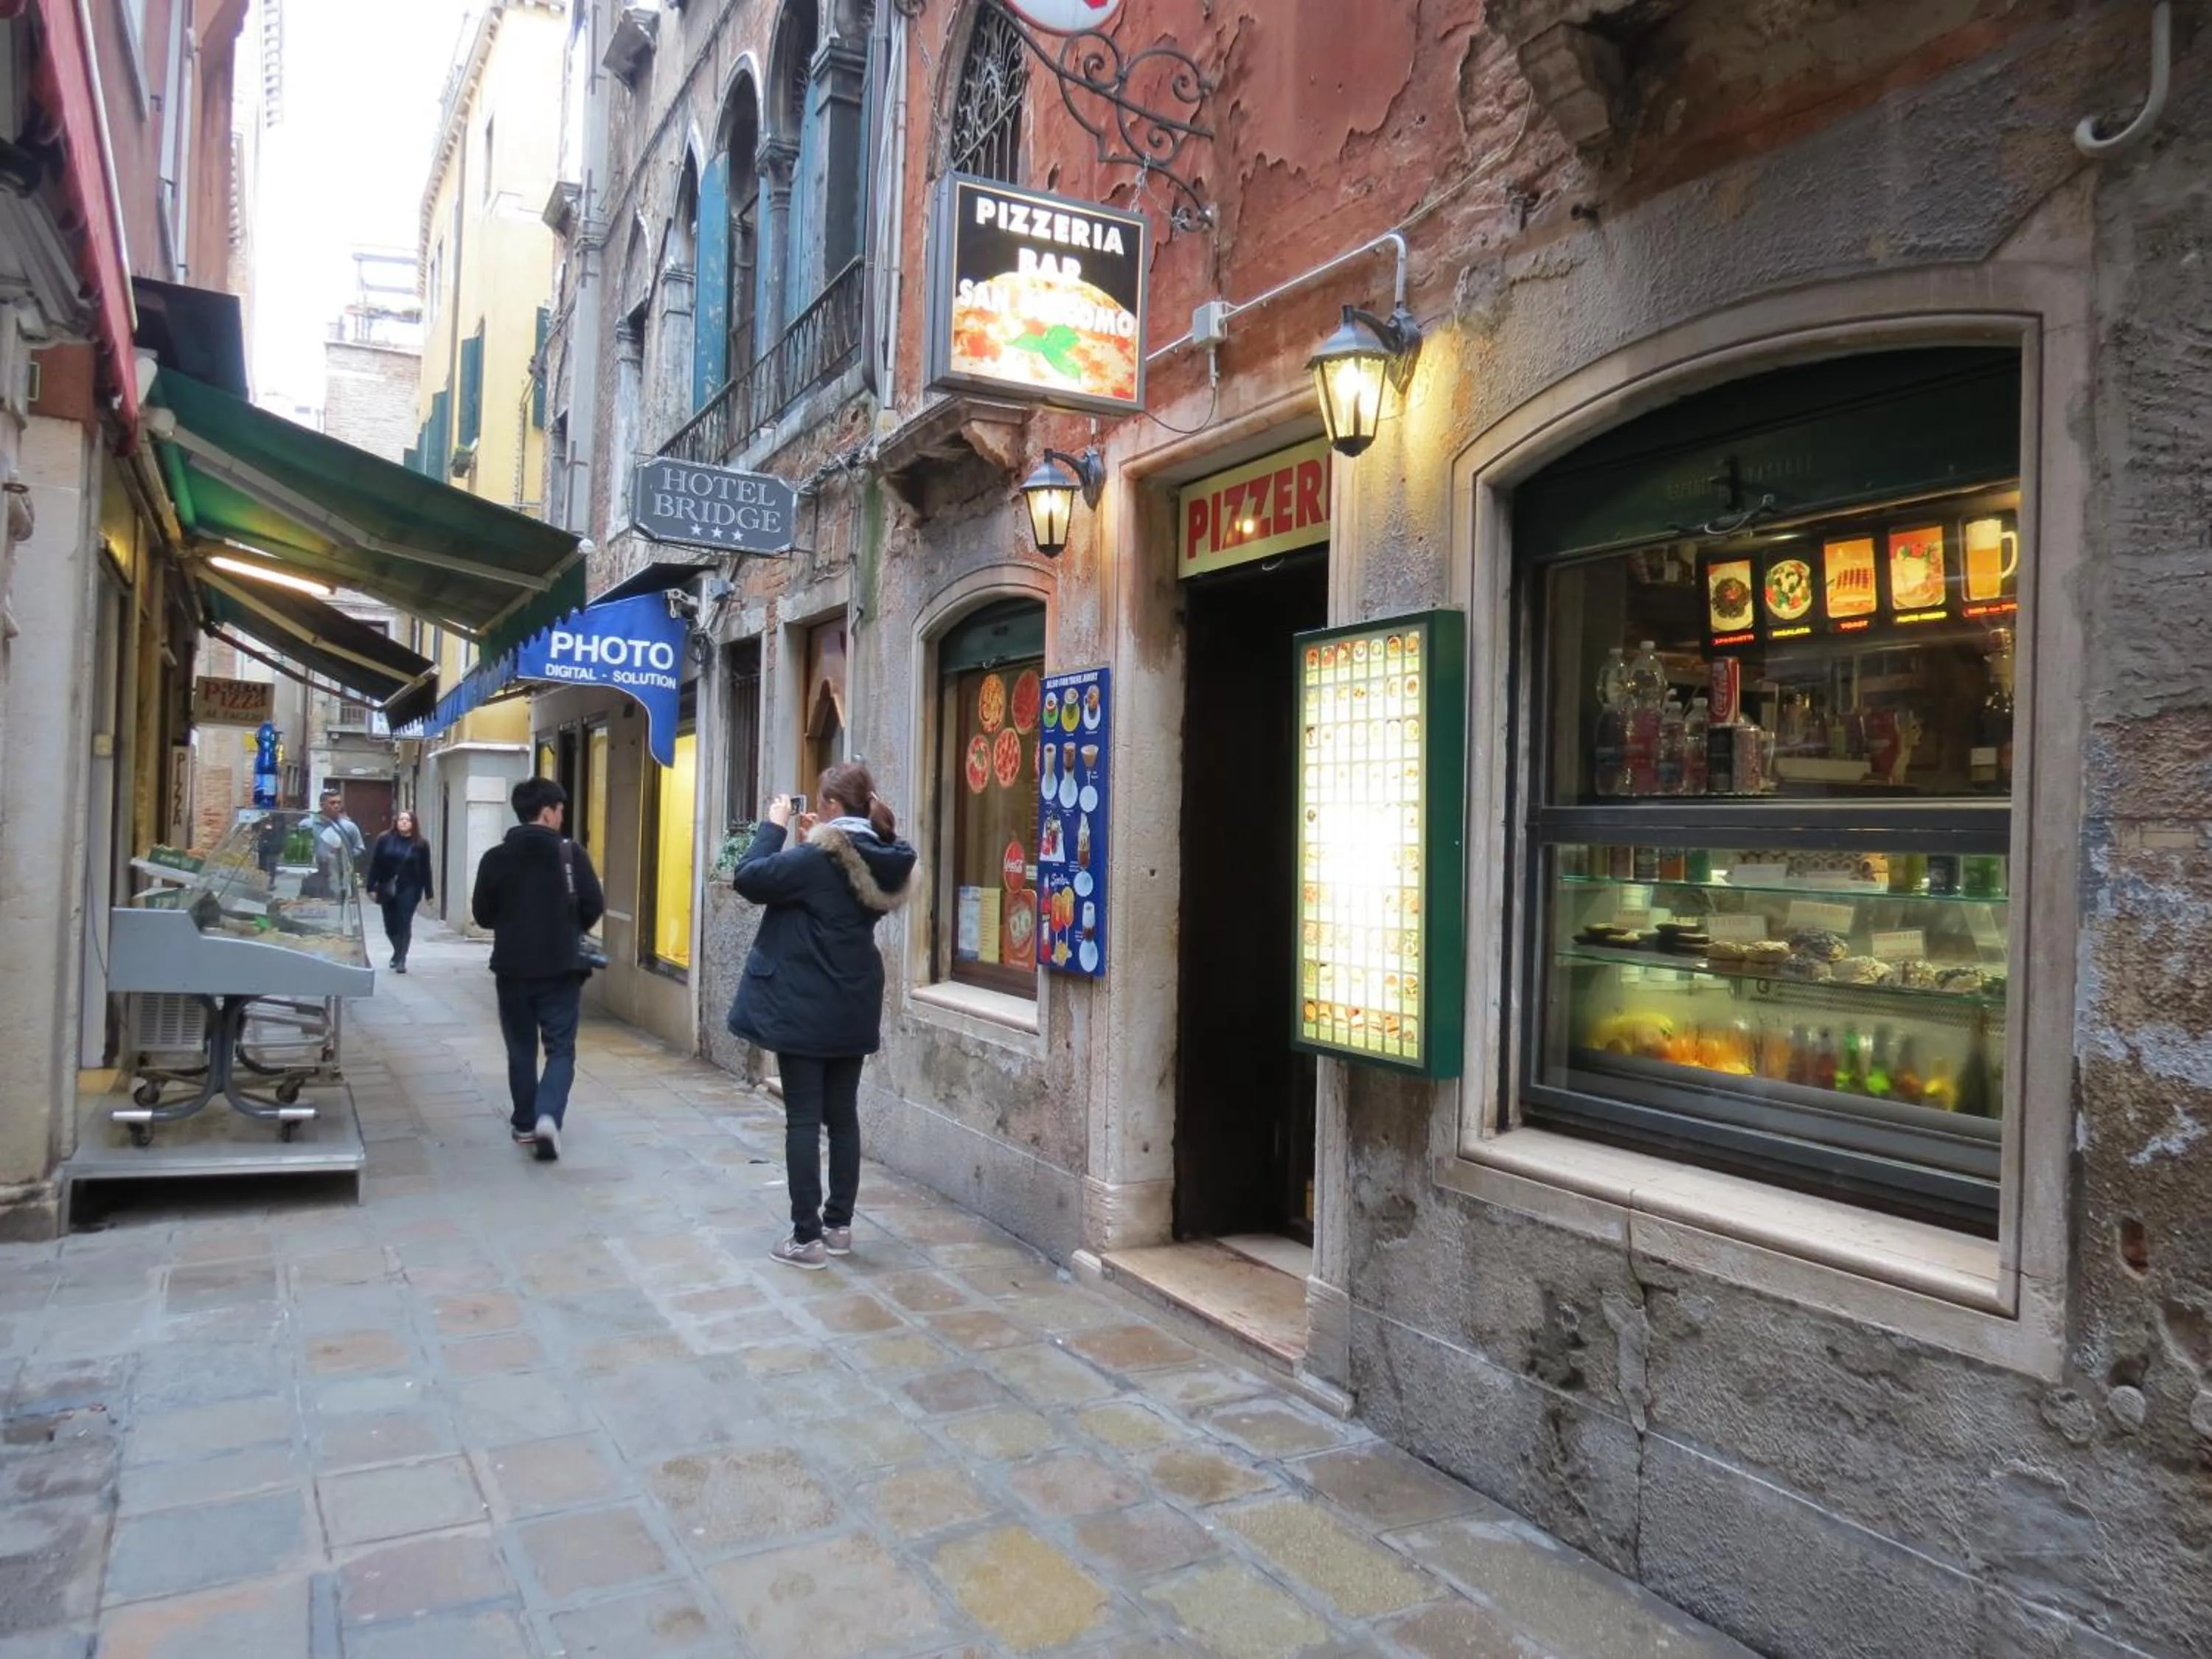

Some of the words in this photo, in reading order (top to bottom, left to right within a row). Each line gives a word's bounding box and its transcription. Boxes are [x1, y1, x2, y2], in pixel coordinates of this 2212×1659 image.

[975, 197, 1124, 256] PIZZERIA
[1018, 248, 1082, 282] BAR
[662, 467, 776, 507] HOTEL
[653, 493, 782, 533] BRIDGE
[549, 631, 675, 670] PHOTO
[545, 664, 597, 681] DIGITAL
[613, 670, 676, 689] SOLUTION
